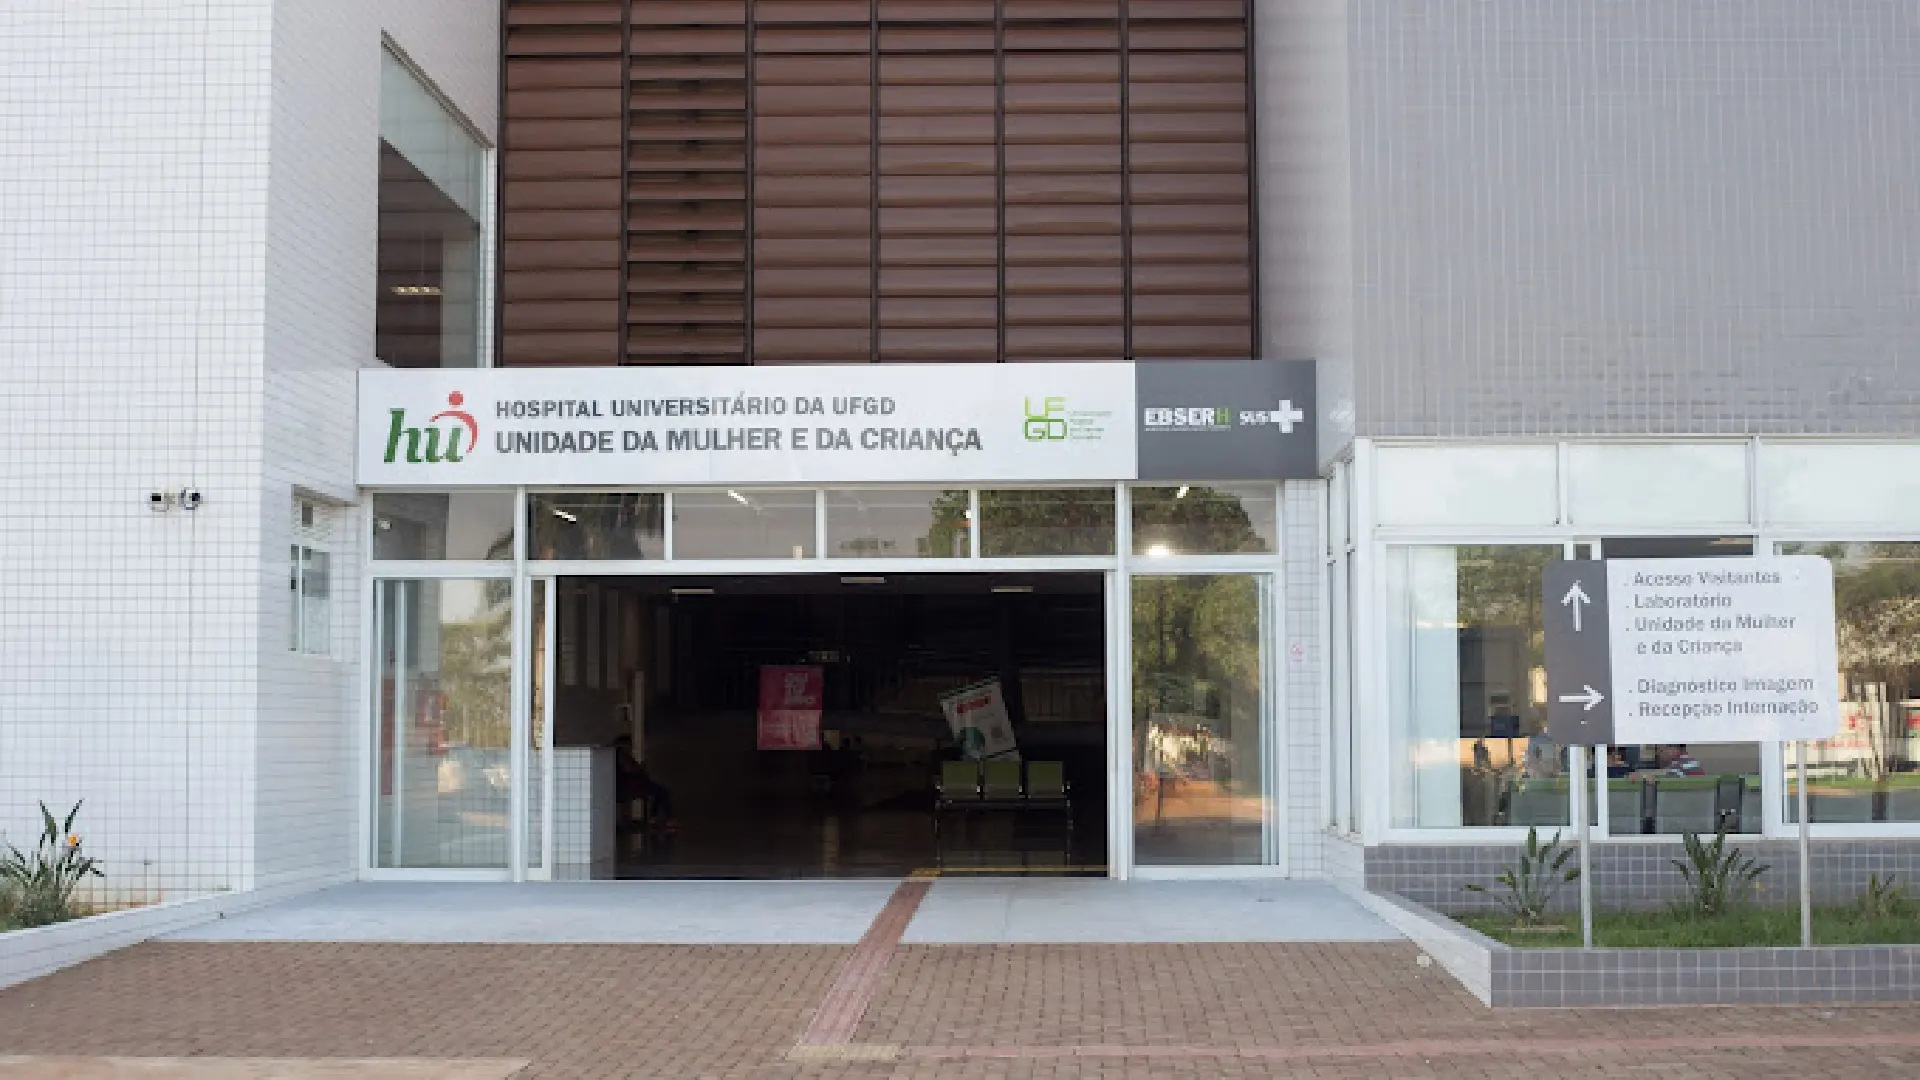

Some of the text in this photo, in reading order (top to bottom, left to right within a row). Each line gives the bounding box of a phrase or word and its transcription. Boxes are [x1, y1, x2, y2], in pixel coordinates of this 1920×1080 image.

[496, 391, 896, 417] HOSPITAL UNIVERSITÁRIO DA UFGD
[495, 427, 984, 457] UNIDADE DA MULHER E DA CRIANÇA
[1633, 569, 1782, 587] Acesso Visitantes
[1634, 592, 1734, 609] Laboratório
[1635, 613, 1797, 632] Unidade da Mulher
[1637, 638, 1743, 655] e da Criança
[1741, 677, 1814, 695] Imagem
[1639, 700, 1724, 720] Recepção
